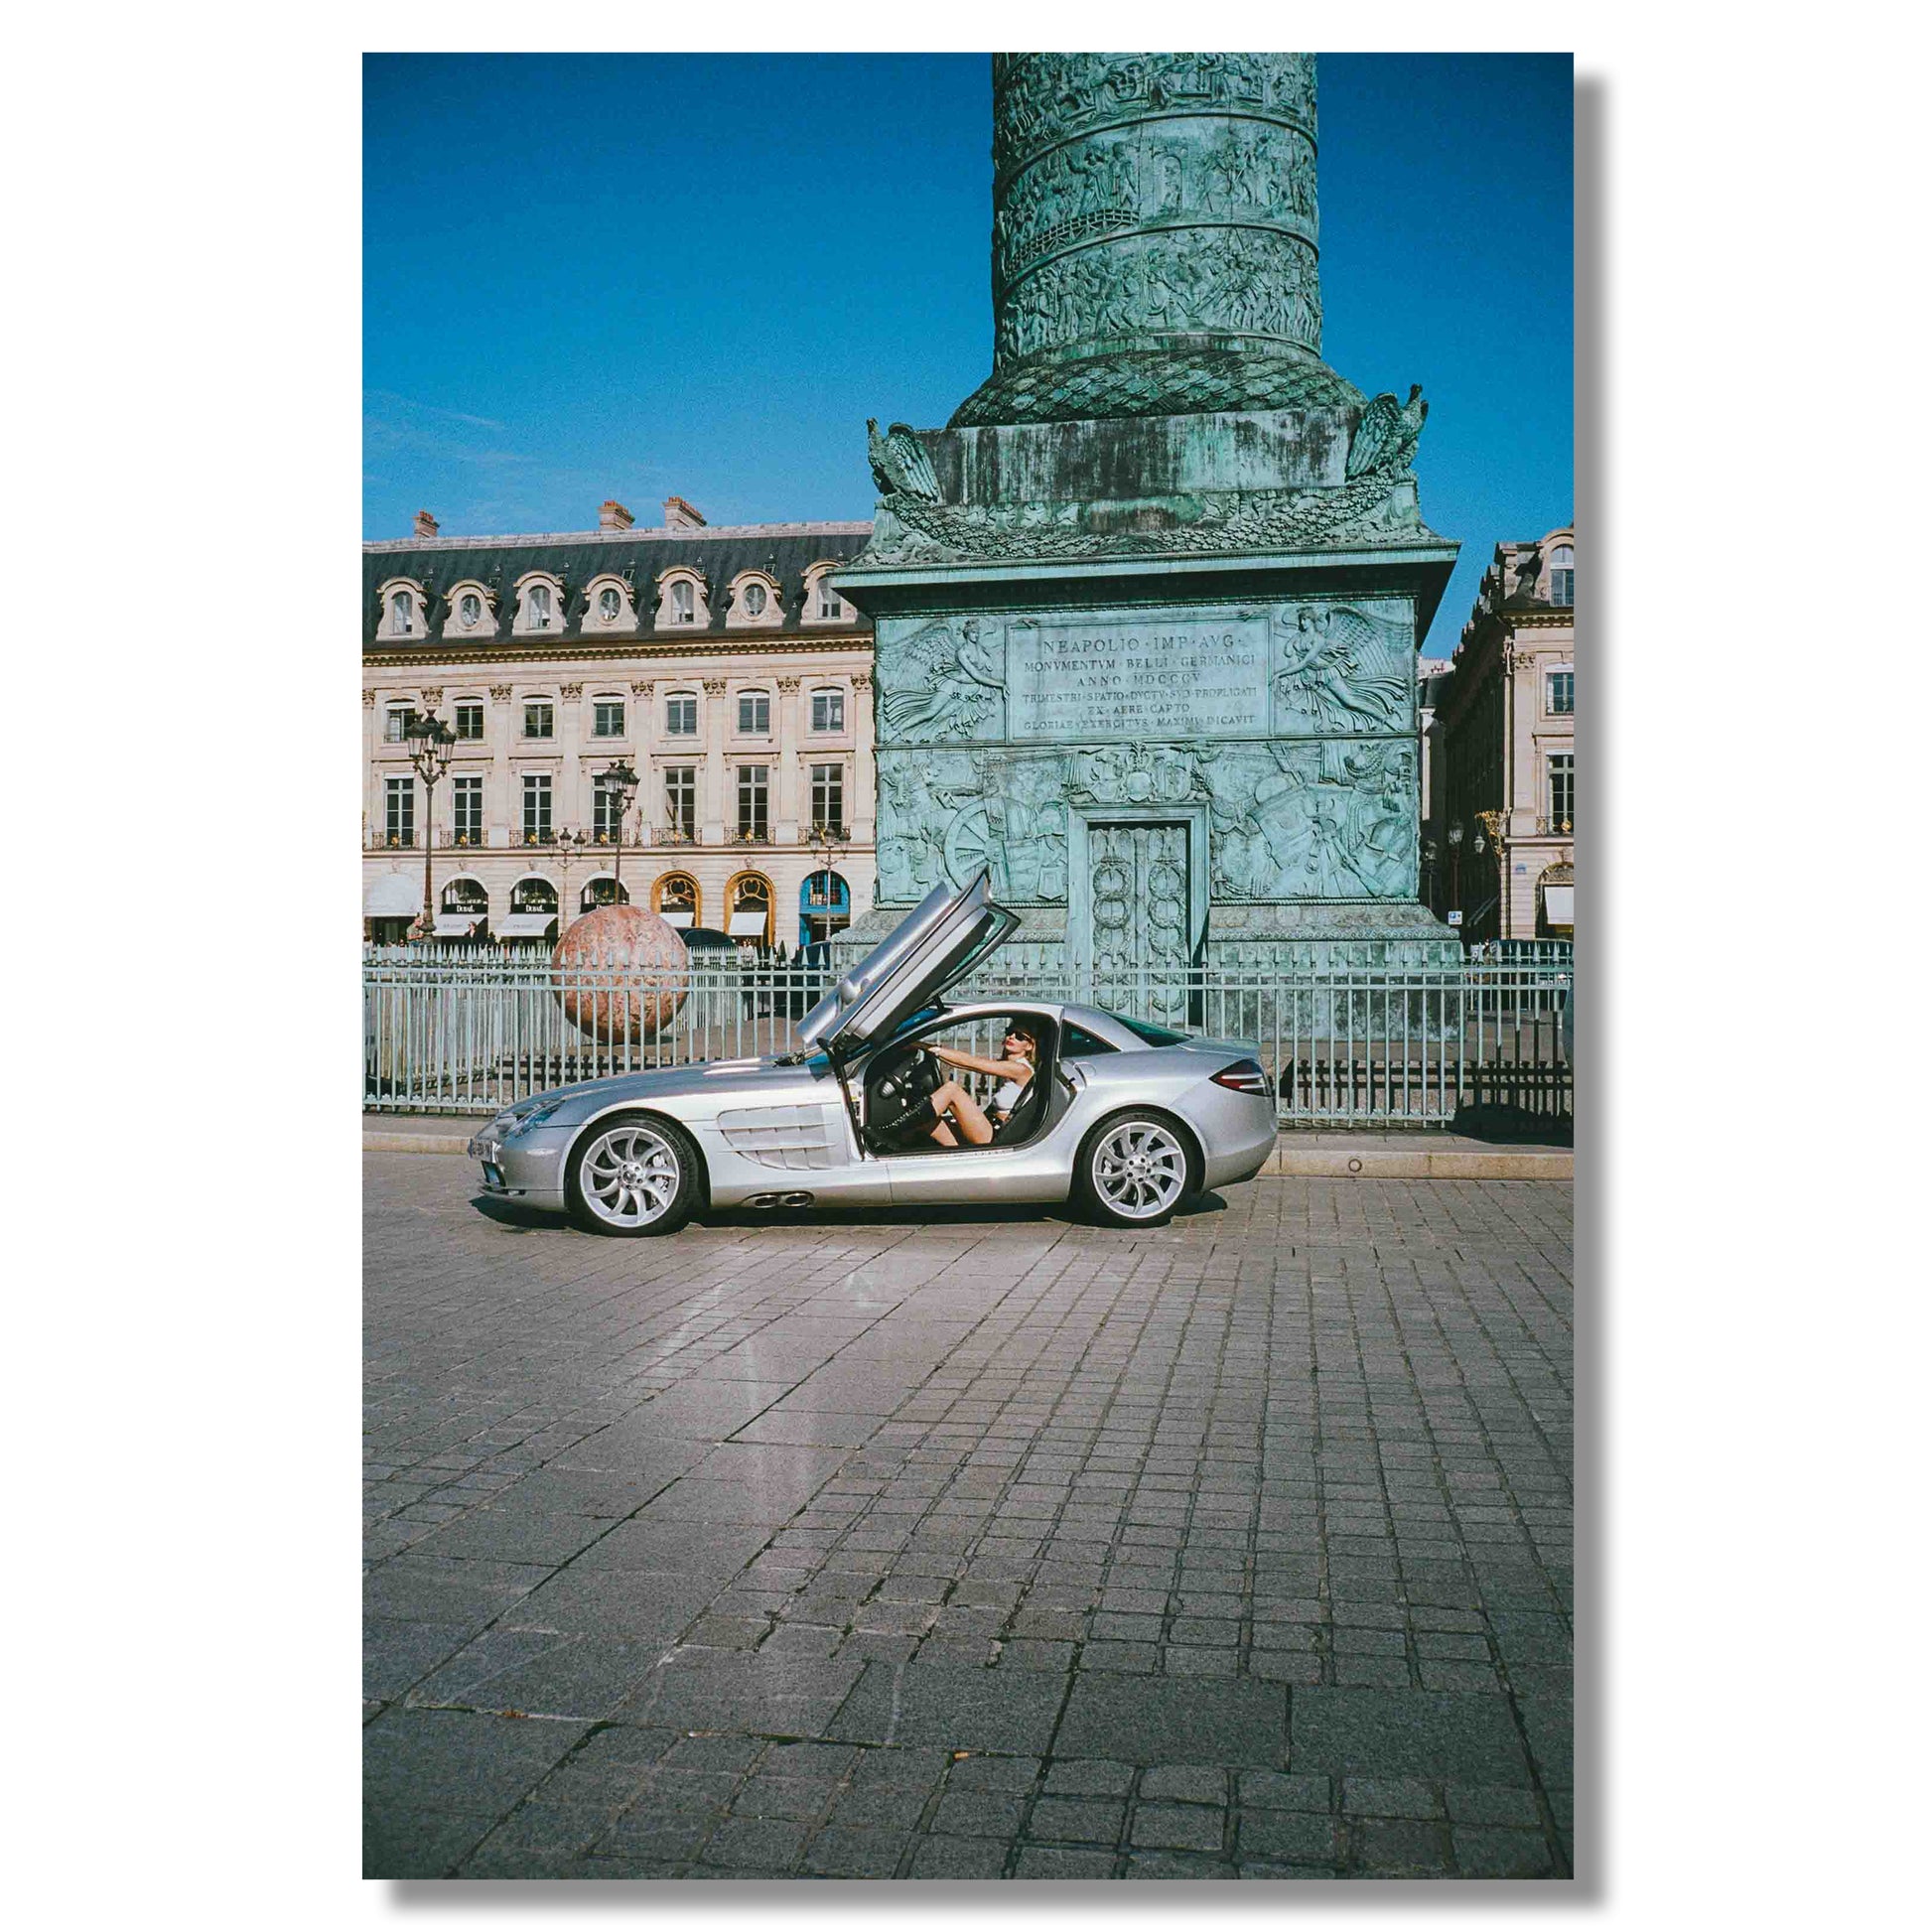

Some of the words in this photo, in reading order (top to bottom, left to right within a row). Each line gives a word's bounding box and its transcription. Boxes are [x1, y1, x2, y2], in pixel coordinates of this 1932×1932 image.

[1043, 638, 1140, 653] NEAPOLIO
[1154, 636, 1187, 650] IMP
[1198, 634, 1234, 648] AVG
[1025, 659, 1116, 673] MONVMENTVM
[1127, 657, 1168, 669] BELLI
[1180, 654, 1255, 667] GERMANICI
[1077, 675, 1122, 687] ANNO
[1086, 691, 1125, 702] SPATIO
[1112, 704, 1144, 715] AERE
[1150, 703, 1190, 714] CAPTO
